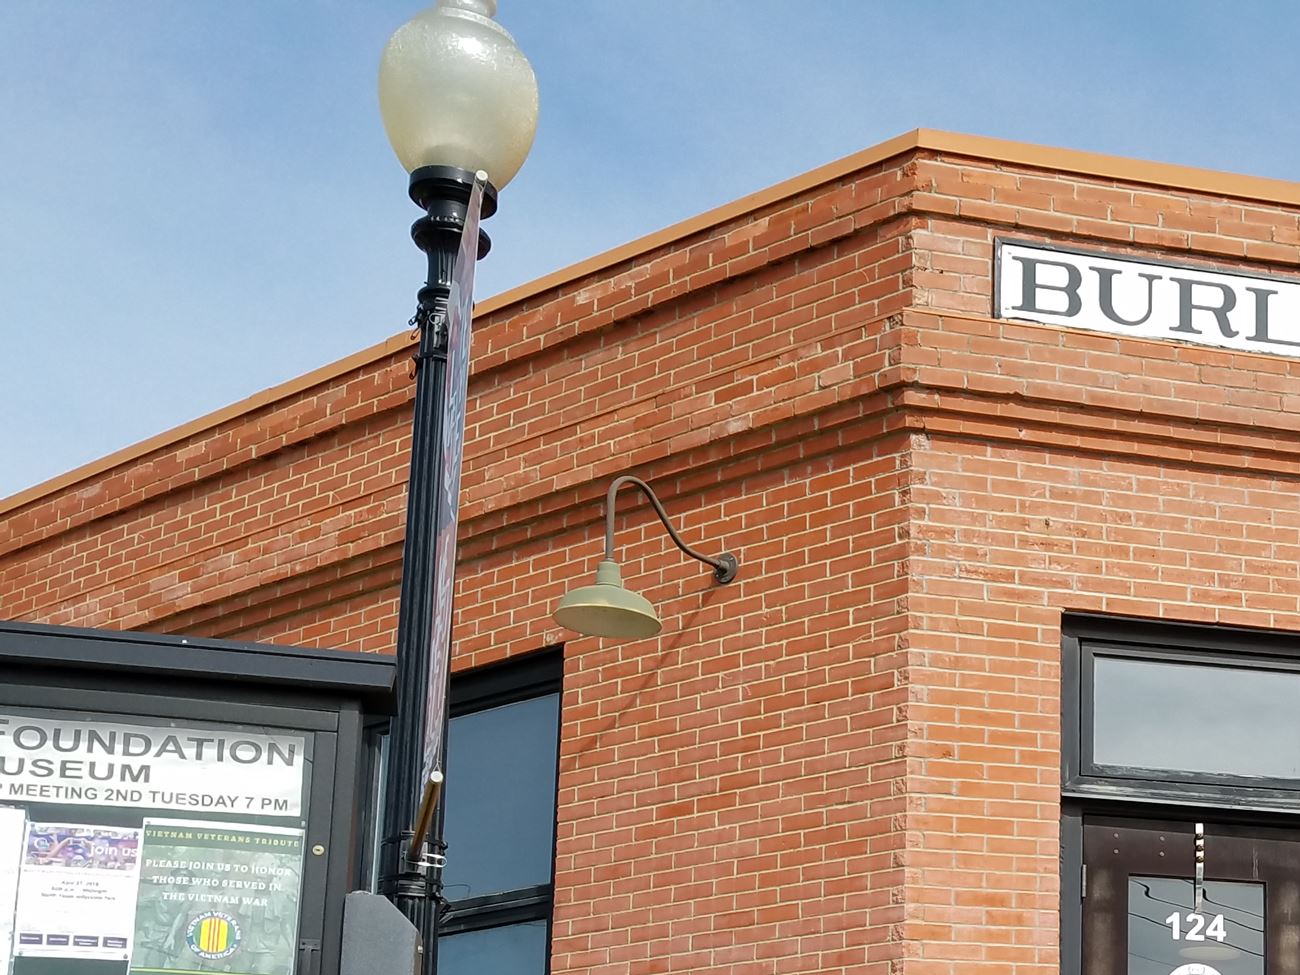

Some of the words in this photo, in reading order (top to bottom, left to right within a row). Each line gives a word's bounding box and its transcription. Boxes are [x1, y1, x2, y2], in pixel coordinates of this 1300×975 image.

[9, 783, 98, 801] MEETING
[105, 788, 143, 802] 2ND
[150, 790, 239, 809] TUESDAY
[244, 796, 255, 810] 7
[260, 798, 289, 812] PM
[145, 830, 193, 840] VIETNAM
[196, 832, 251, 844] VETERANS
[255, 837, 300, 848] TRIBUTE
[90, 841, 118, 857] join
[122, 847, 138, 857] us
[145, 858, 188, 869] PLEASE
[189, 860, 215, 871] JOIN
[217, 863, 231, 872] US
[233, 864, 248, 874] TO
[251, 865, 291, 877] HONOR
[152, 875, 188, 885] THOSE
[191, 876, 219, 887] WHO
[222, 880, 266, 890] SERVED
[269, 882, 282, 892] IN
[162, 892, 186, 901] THE
[187, 892, 240, 905] VIETNAM
[242, 897, 268, 907] WAR
[1165, 911, 1228, 942] 124
